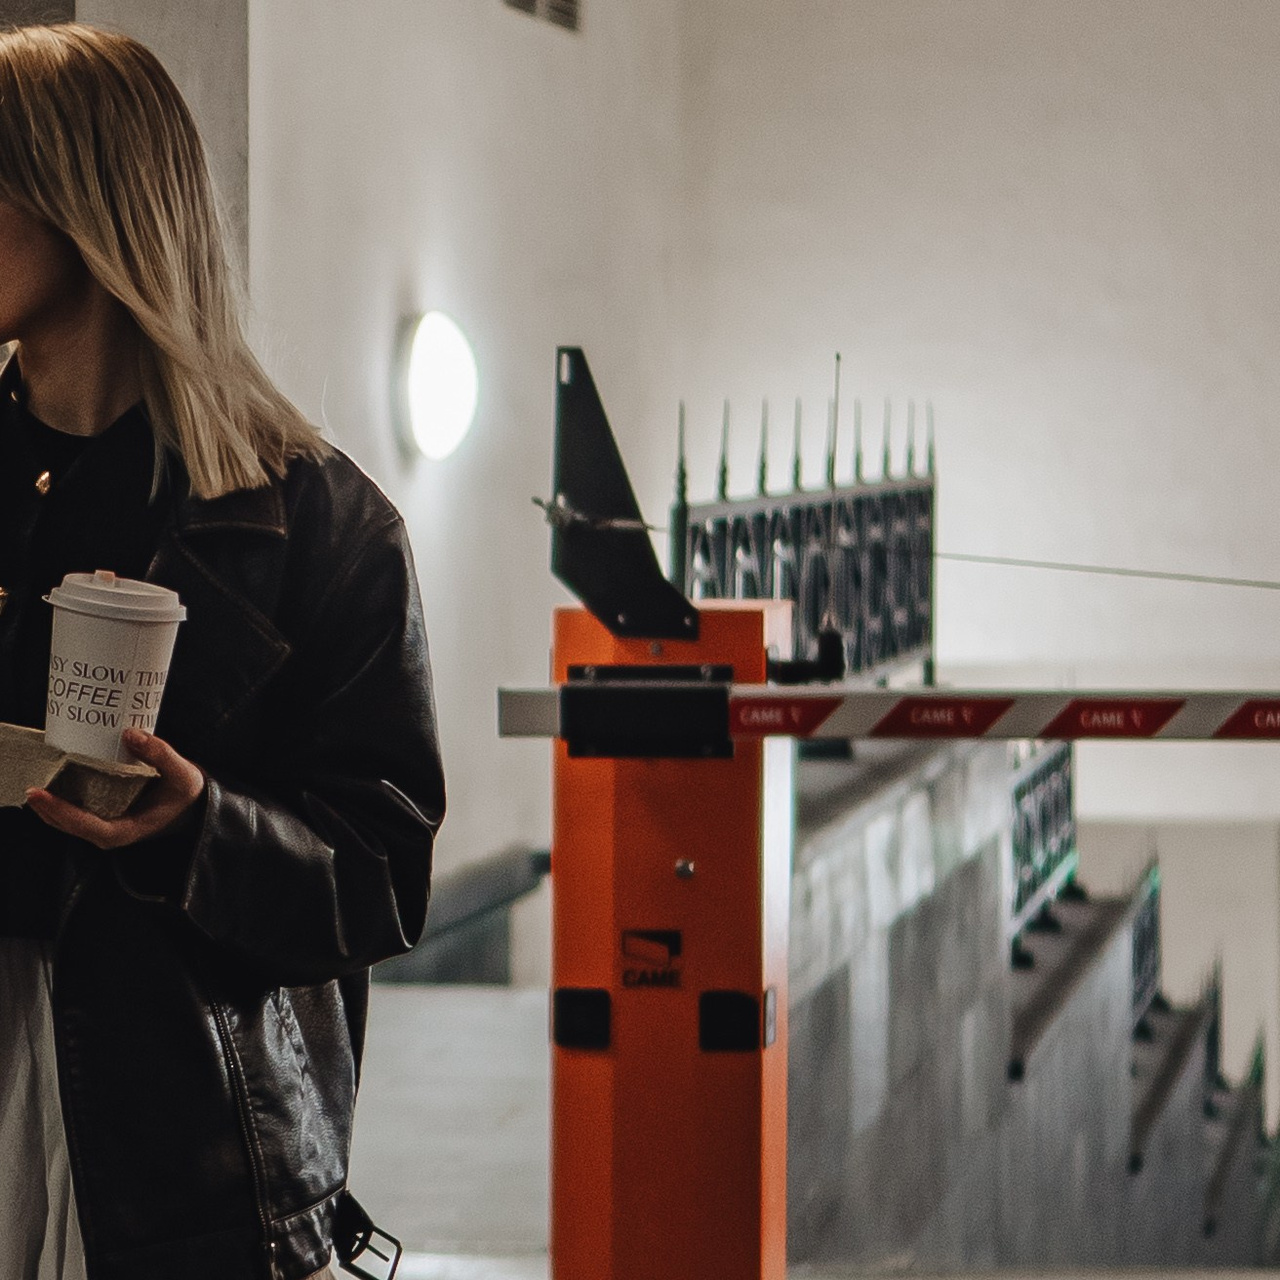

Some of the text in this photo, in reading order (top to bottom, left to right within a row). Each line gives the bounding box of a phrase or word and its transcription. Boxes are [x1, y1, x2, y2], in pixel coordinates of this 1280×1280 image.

[51, 656, 68, 672] SY
[72, 661, 131, 684] SLOW
[66, 704, 121, 729] SLOW
[739, 705, 784, 725] CAME
[910, 706, 955, 725] CAME
[1080, 709, 1125, 729] CAME
[623, 969, 681, 988] CAME
